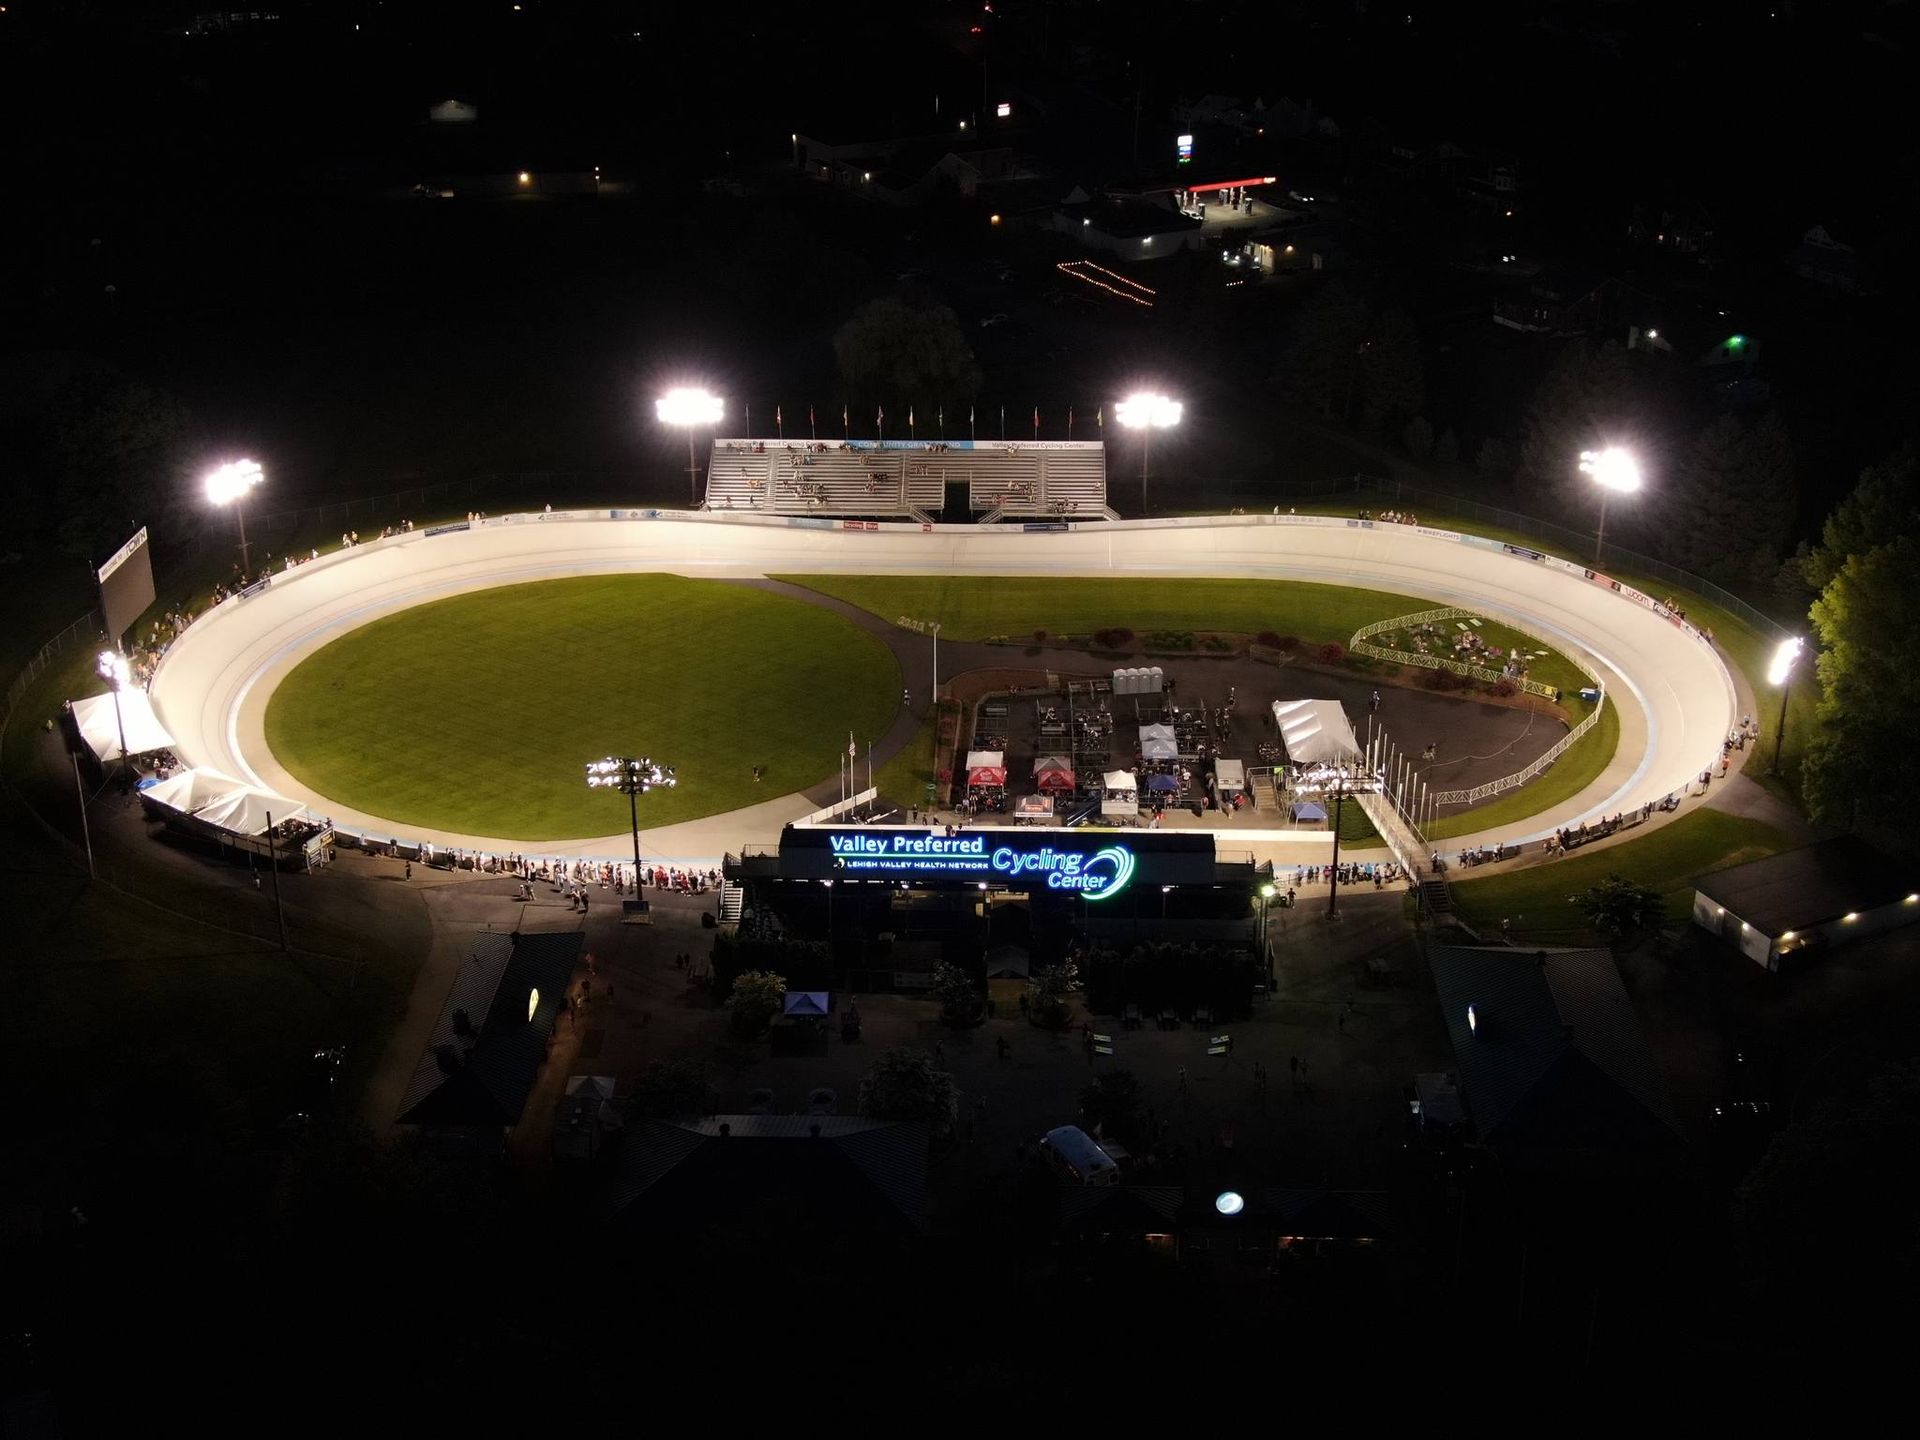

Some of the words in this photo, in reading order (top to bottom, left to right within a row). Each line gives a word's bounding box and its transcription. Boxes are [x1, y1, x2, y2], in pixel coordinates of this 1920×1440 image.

[1040, 442, 1063, 450] Cycling
[830, 836, 889, 854] Valley
[894, 836, 983, 853] Preferred
[992, 847, 1083, 875] Cycling
[1048, 872, 1107, 888] Center
